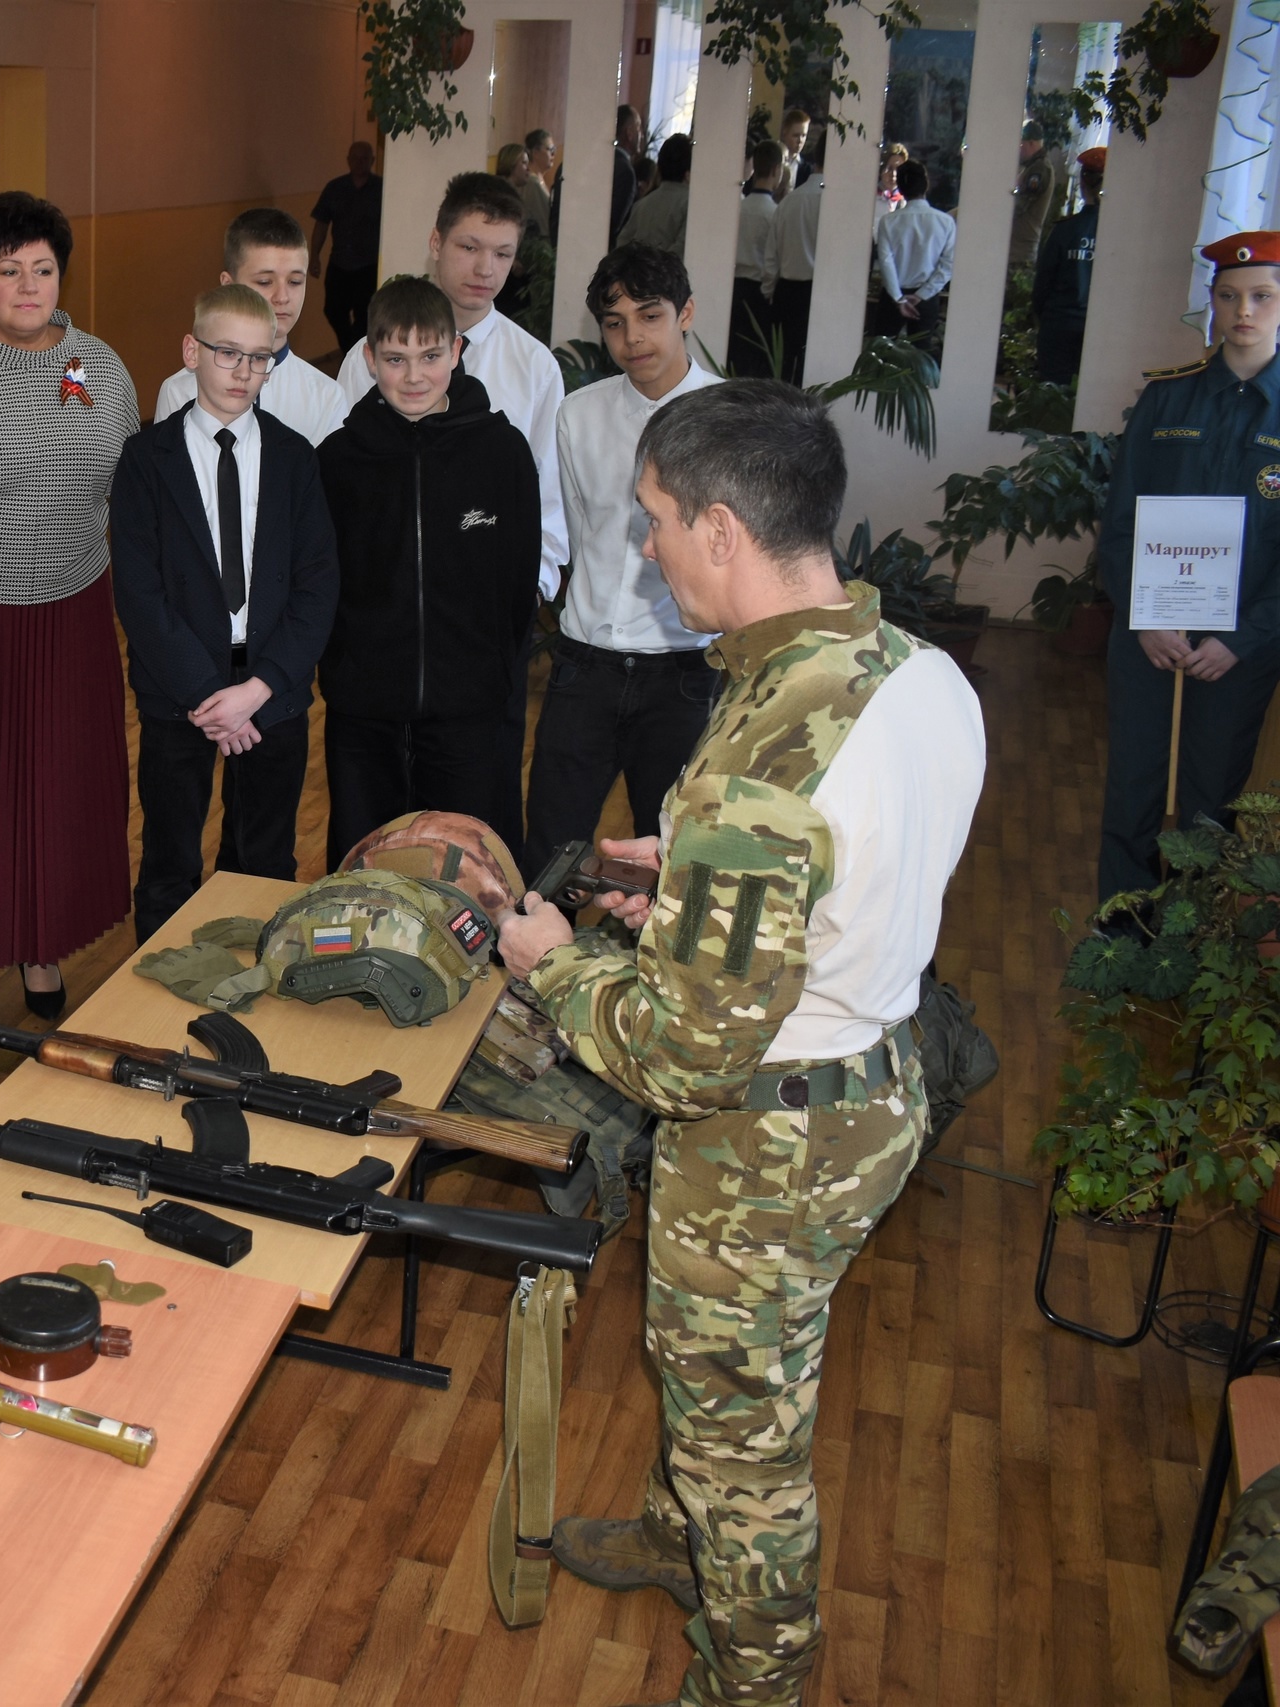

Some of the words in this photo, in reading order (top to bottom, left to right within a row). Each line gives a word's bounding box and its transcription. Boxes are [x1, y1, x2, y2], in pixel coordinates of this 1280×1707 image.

[1154, 430, 1168, 438] МЧС
[1169, 428, 1200, 436] РОССИИ
[1144, 543, 1231, 559] Маршрут
[1178, 562, 1193, 576] И
